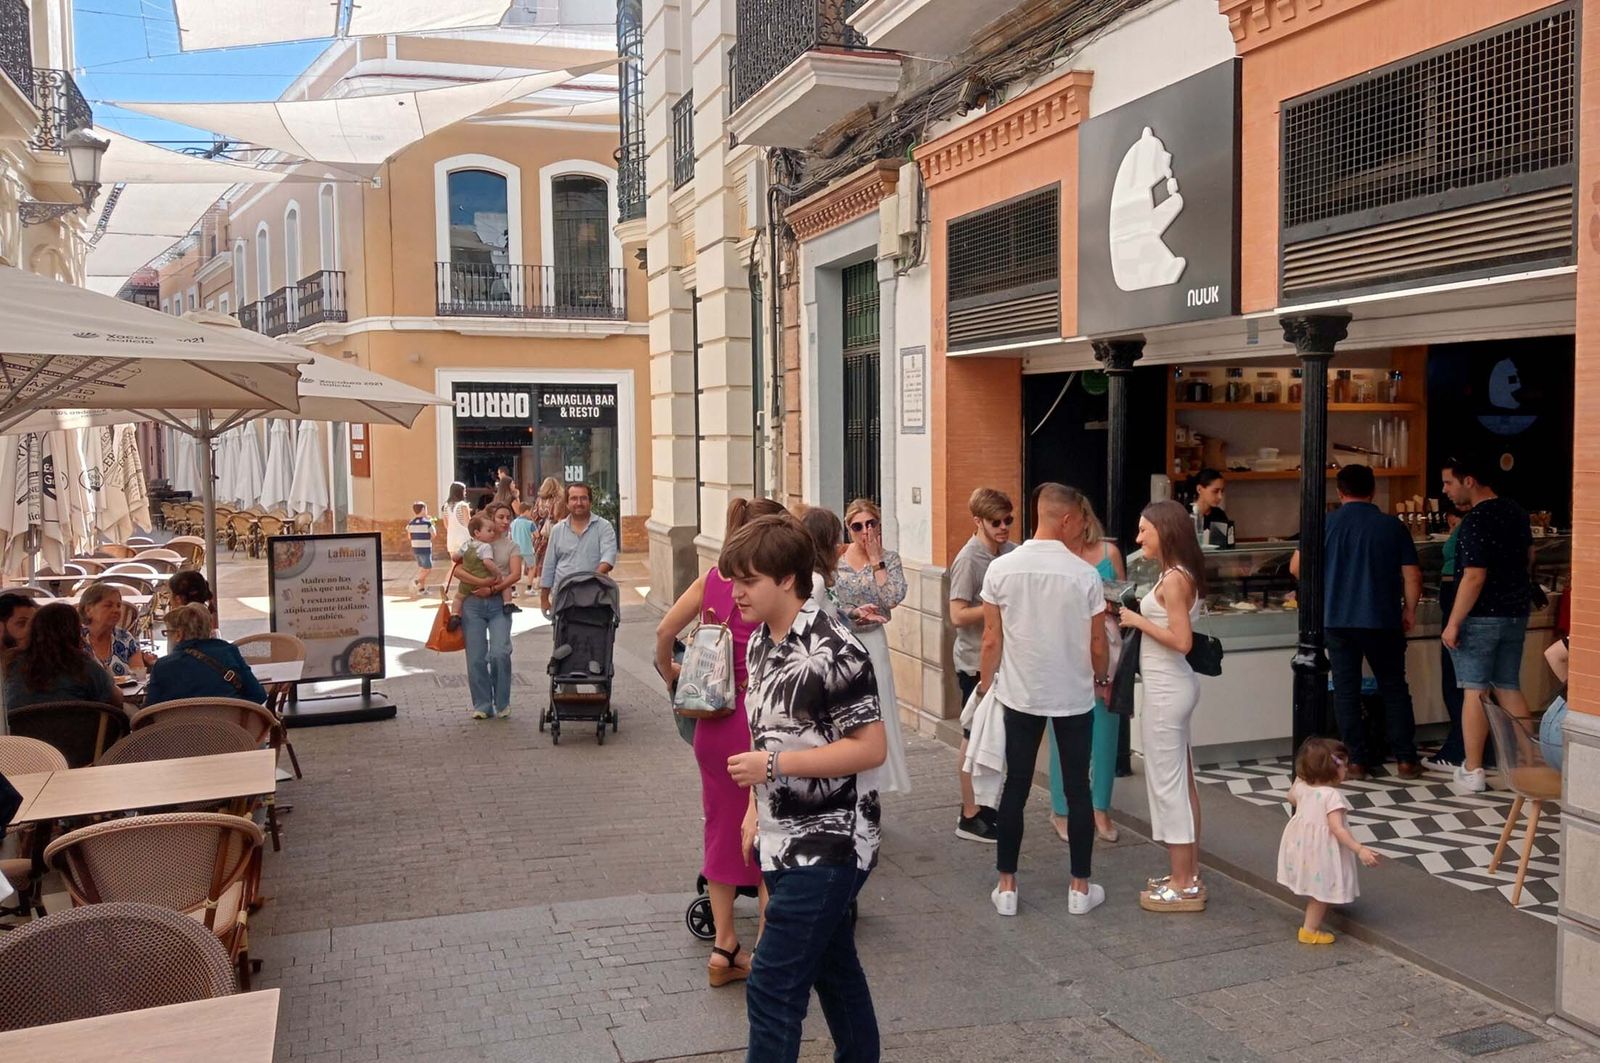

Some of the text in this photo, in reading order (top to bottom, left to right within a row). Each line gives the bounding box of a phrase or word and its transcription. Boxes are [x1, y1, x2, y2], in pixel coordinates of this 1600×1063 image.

[455, 392, 529, 417] BURRO
[543, 394, 614, 406] CANAGLIA BAR
[560, 406, 600, 417] & RESTO
[339, 575, 352, 584] hay
[307, 596, 353, 604] restaurante
